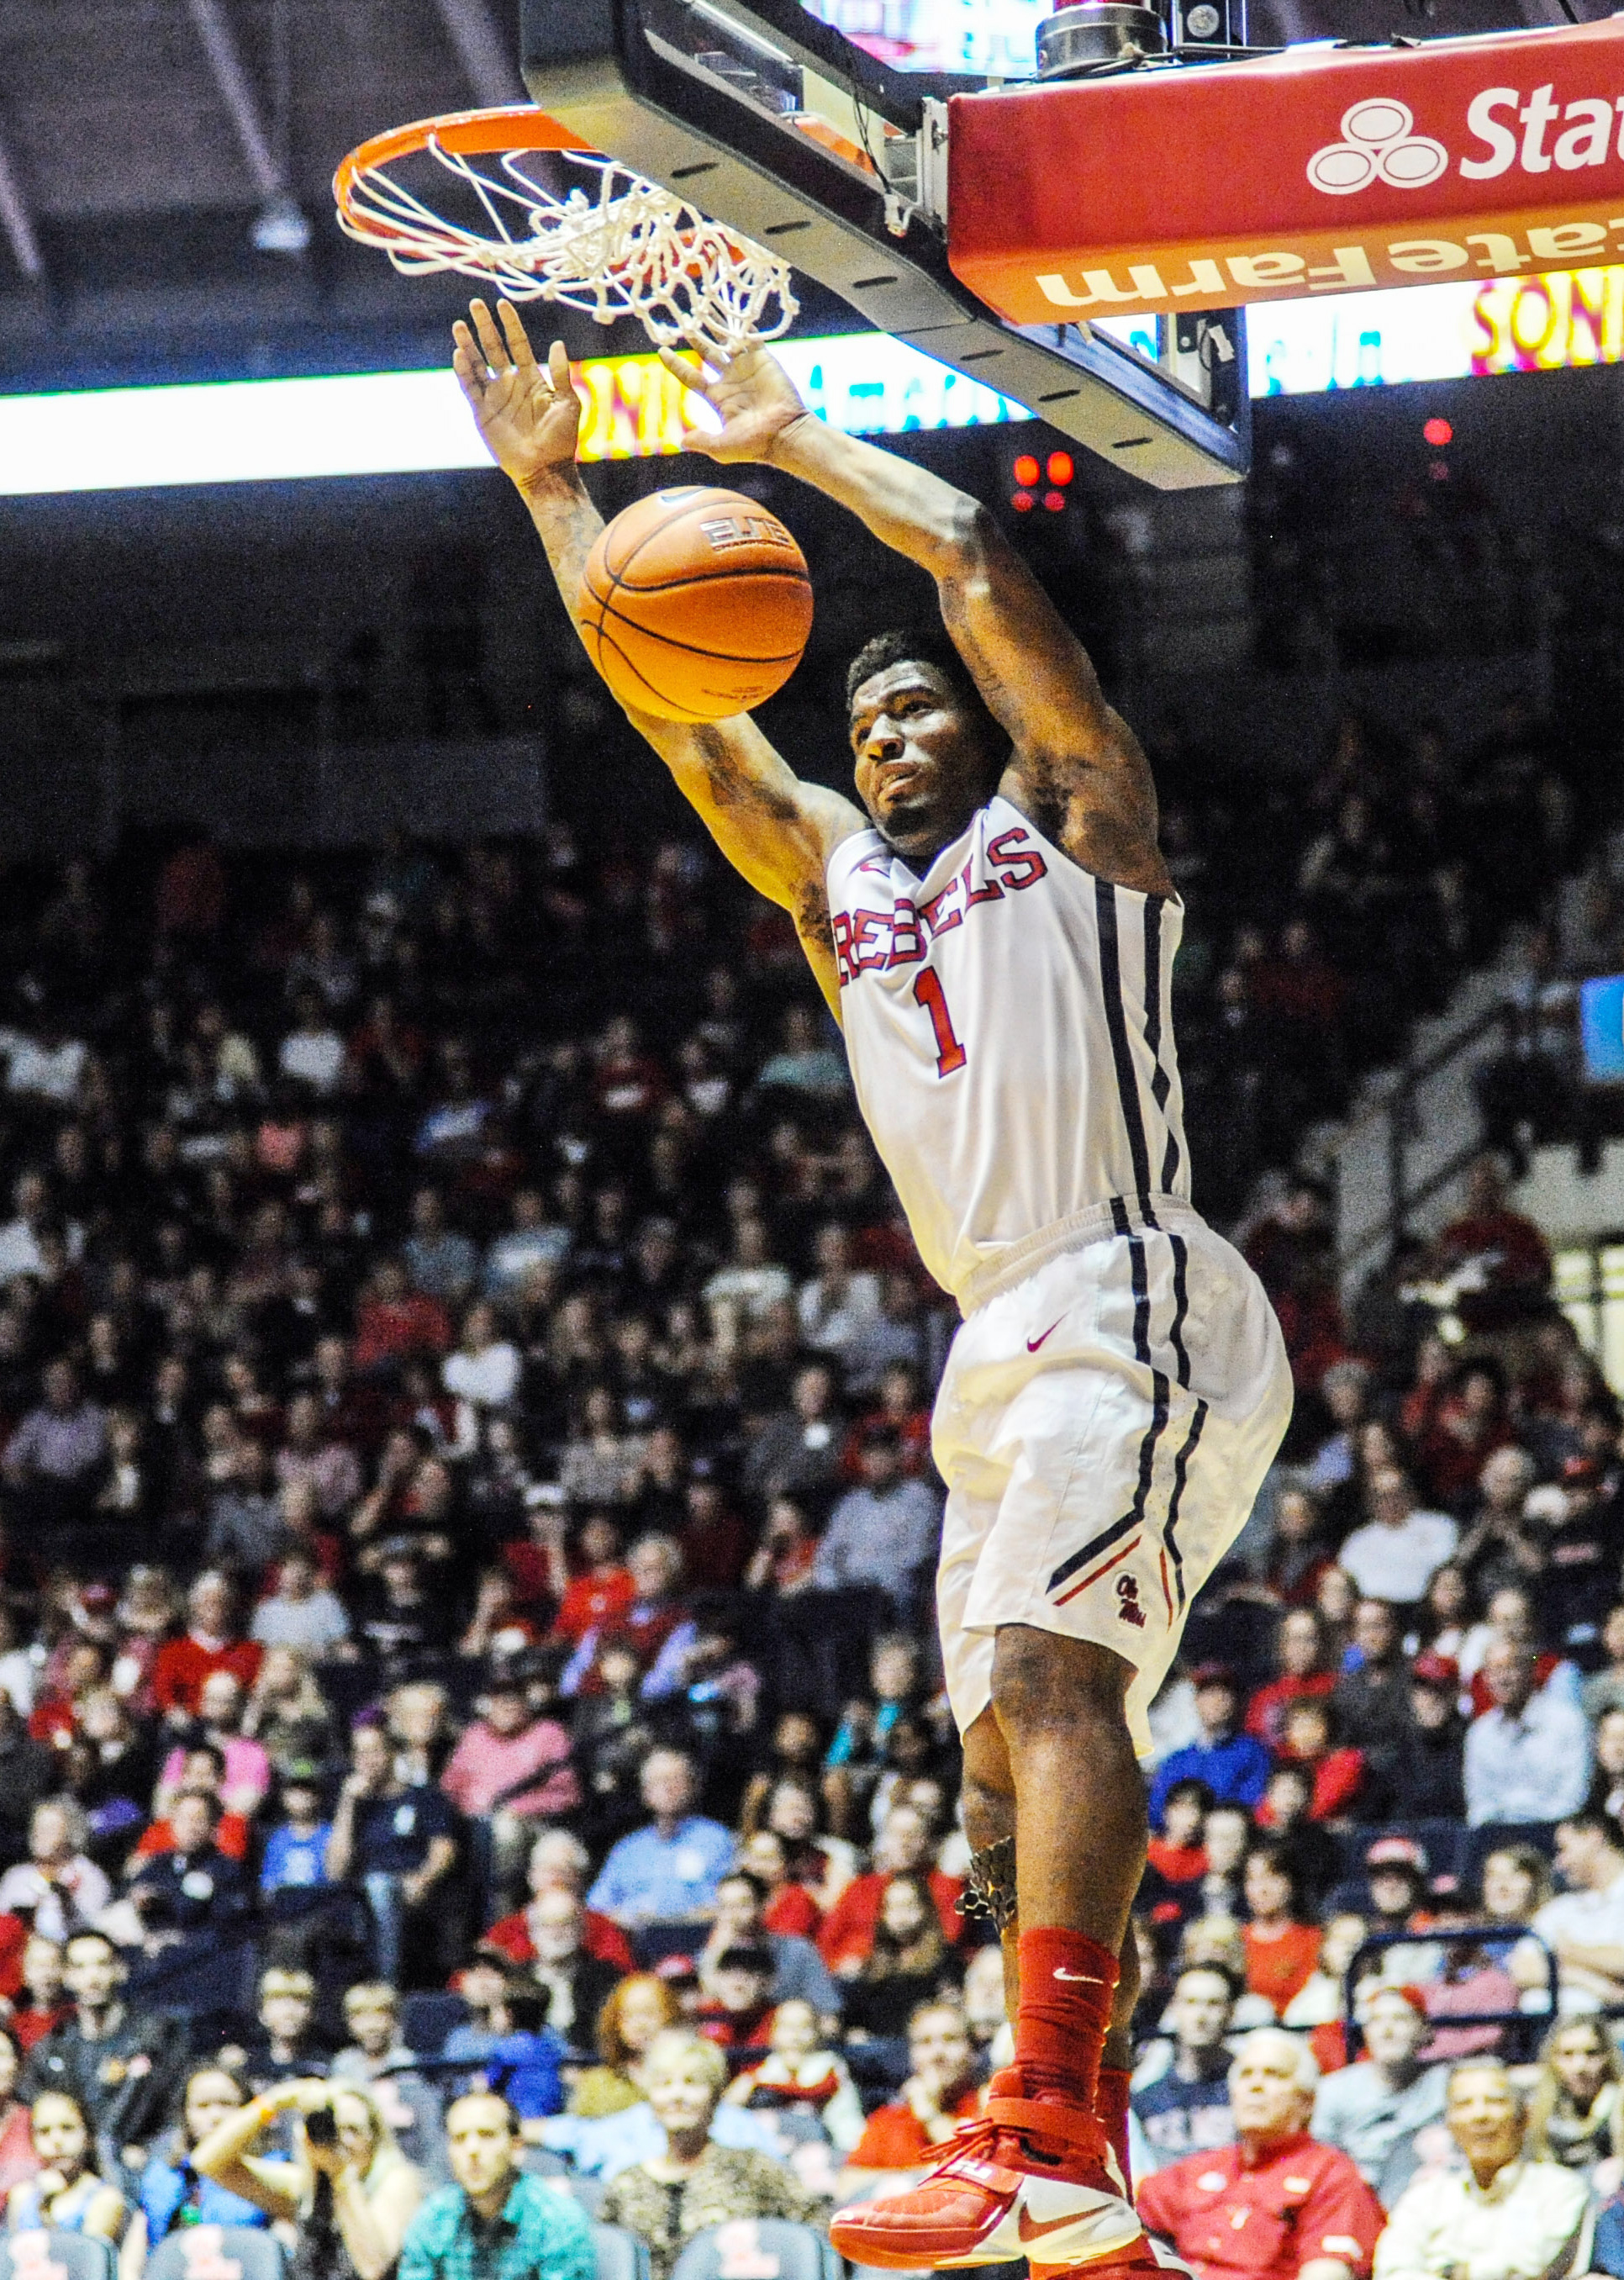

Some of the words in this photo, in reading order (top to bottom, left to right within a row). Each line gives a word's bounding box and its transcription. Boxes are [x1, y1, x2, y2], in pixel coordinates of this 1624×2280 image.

[1459, 83, 1624, 179] Sta
[1036, 245, 1377, 306] Farm
[1388, 217, 1624, 273] ate
[700, 516, 790, 547] ELITE
[833, 827, 1048, 987] REBELS
[912, 964, 968, 1079] 1
